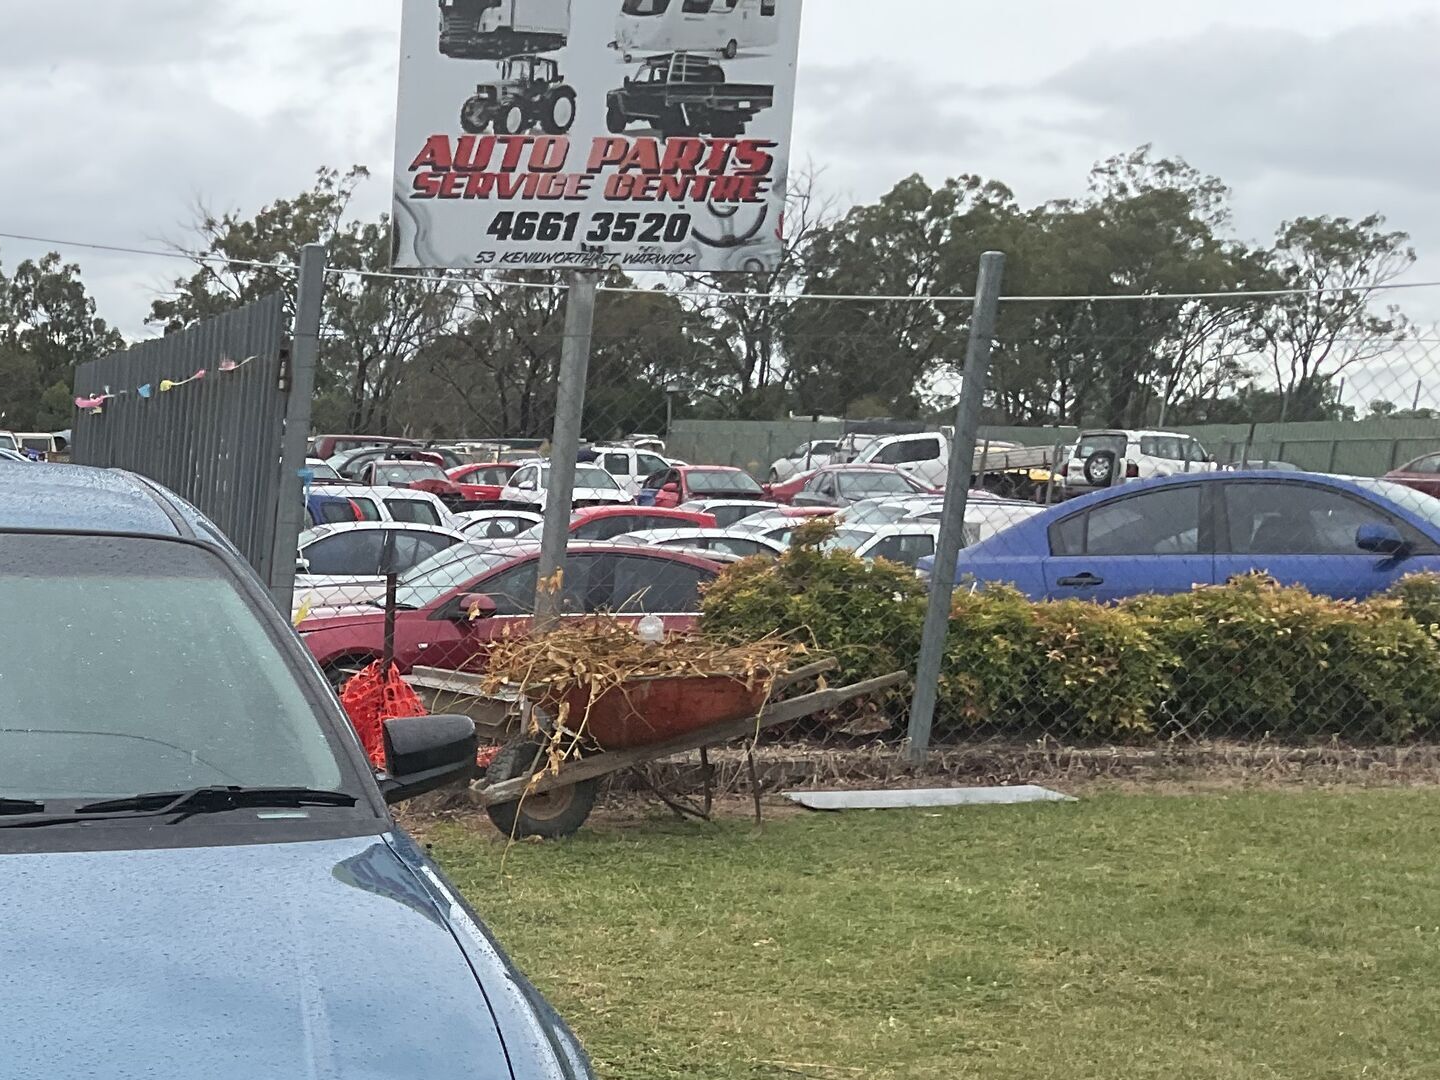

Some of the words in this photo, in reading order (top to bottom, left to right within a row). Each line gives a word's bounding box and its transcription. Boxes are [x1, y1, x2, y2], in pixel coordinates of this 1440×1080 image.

[408, 134, 570, 173] AUTO
[586, 136, 778, 176] PARTS
[409, 172, 594, 199] SERVICE
[604, 174, 772, 203] CENTRE
[487, 211, 577, 241] 4661
[586, 213, 691, 243] 3520
[474, 251, 496, 264] 53
[500, 252, 597, 264] KENILWORTH
[599, 252, 622, 265] ST
[622, 253, 697, 265] WARWICK
